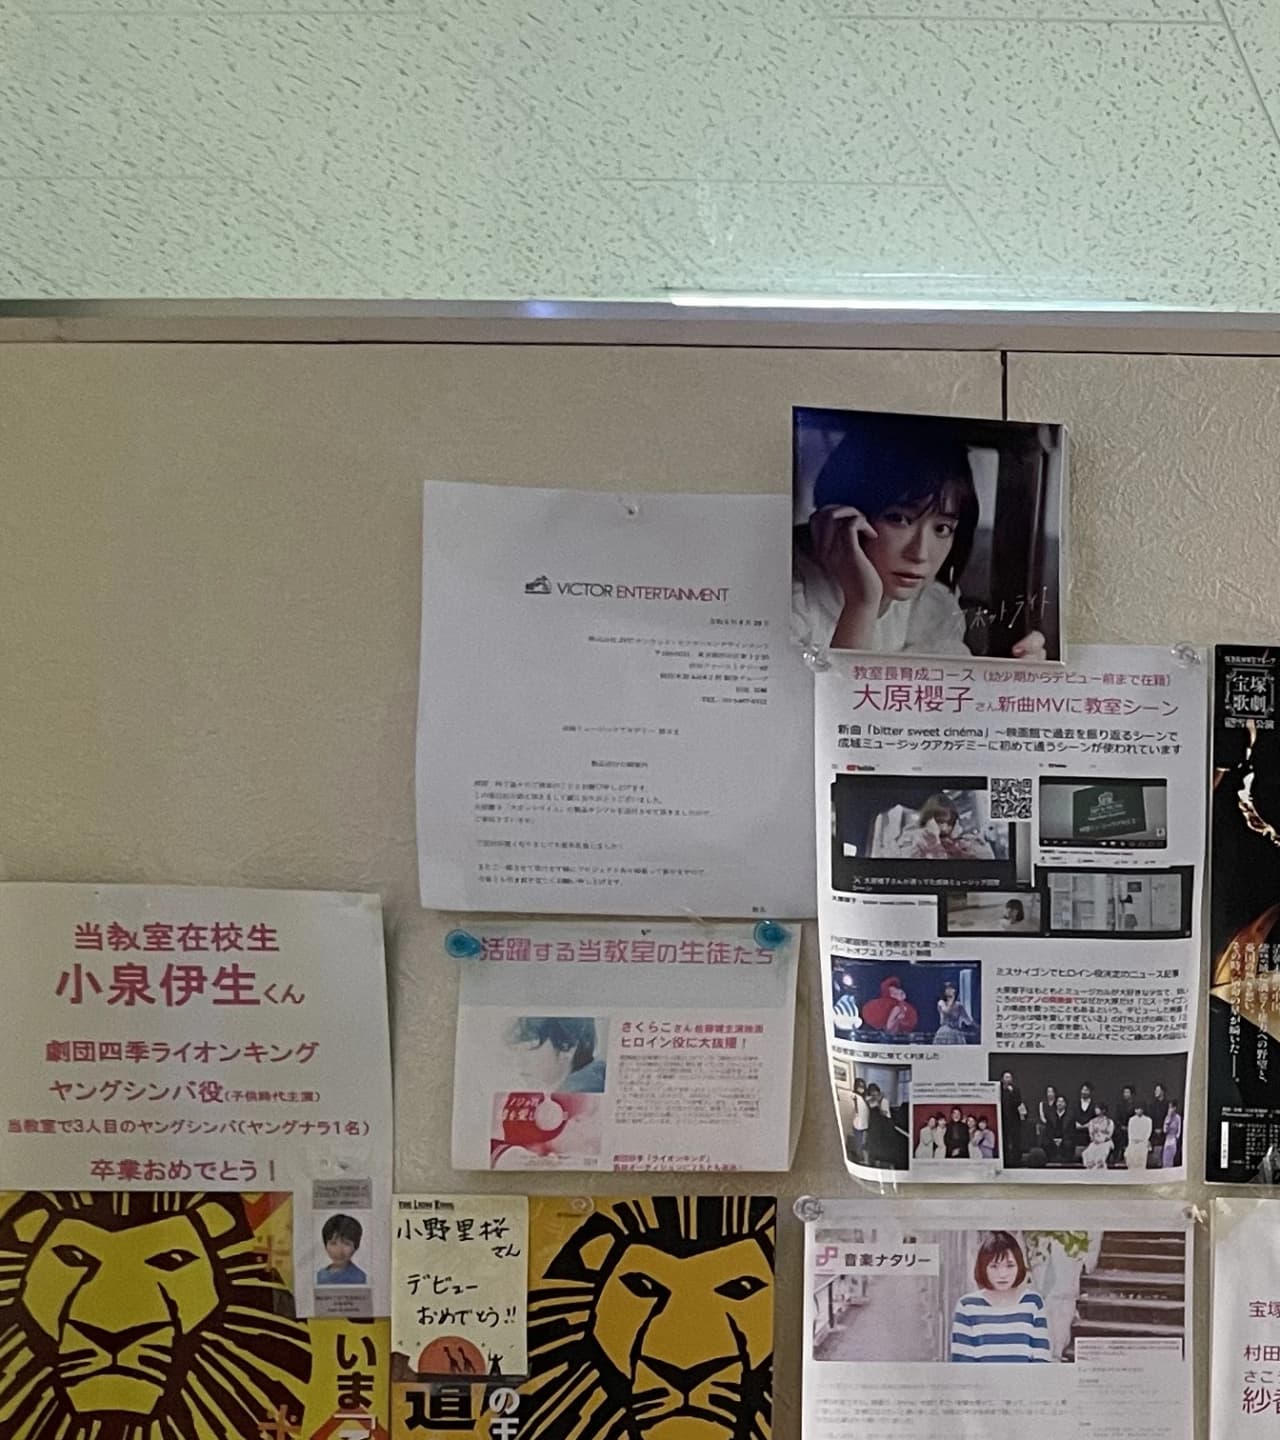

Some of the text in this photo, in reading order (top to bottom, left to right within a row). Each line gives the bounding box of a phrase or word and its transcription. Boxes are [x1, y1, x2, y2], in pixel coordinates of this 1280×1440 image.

[557, 583, 729, 602] VICTOR ENTERTAINMENT
[1232, 673, 1268, 692] 宝塚
[852, 685, 1179, 717] 大原櫻子さん新曲MVに教室シーン
[1232, 694, 1268, 713] 歌劇
[74, 922, 280, 952] 当教室在校生
[481, 937, 774, 966] 活躍する当教室の生徒たち
[55, 963, 305, 1007] 小泉伊生くん
[46, 1040, 320, 1064] 劇団四季ライオンキング
[90, 1160, 276, 1182] 卒業おめでとう！
[843, 1252, 932, 1269] 音楽ナタリー
[407, 1273, 478, 1295] デビュー
